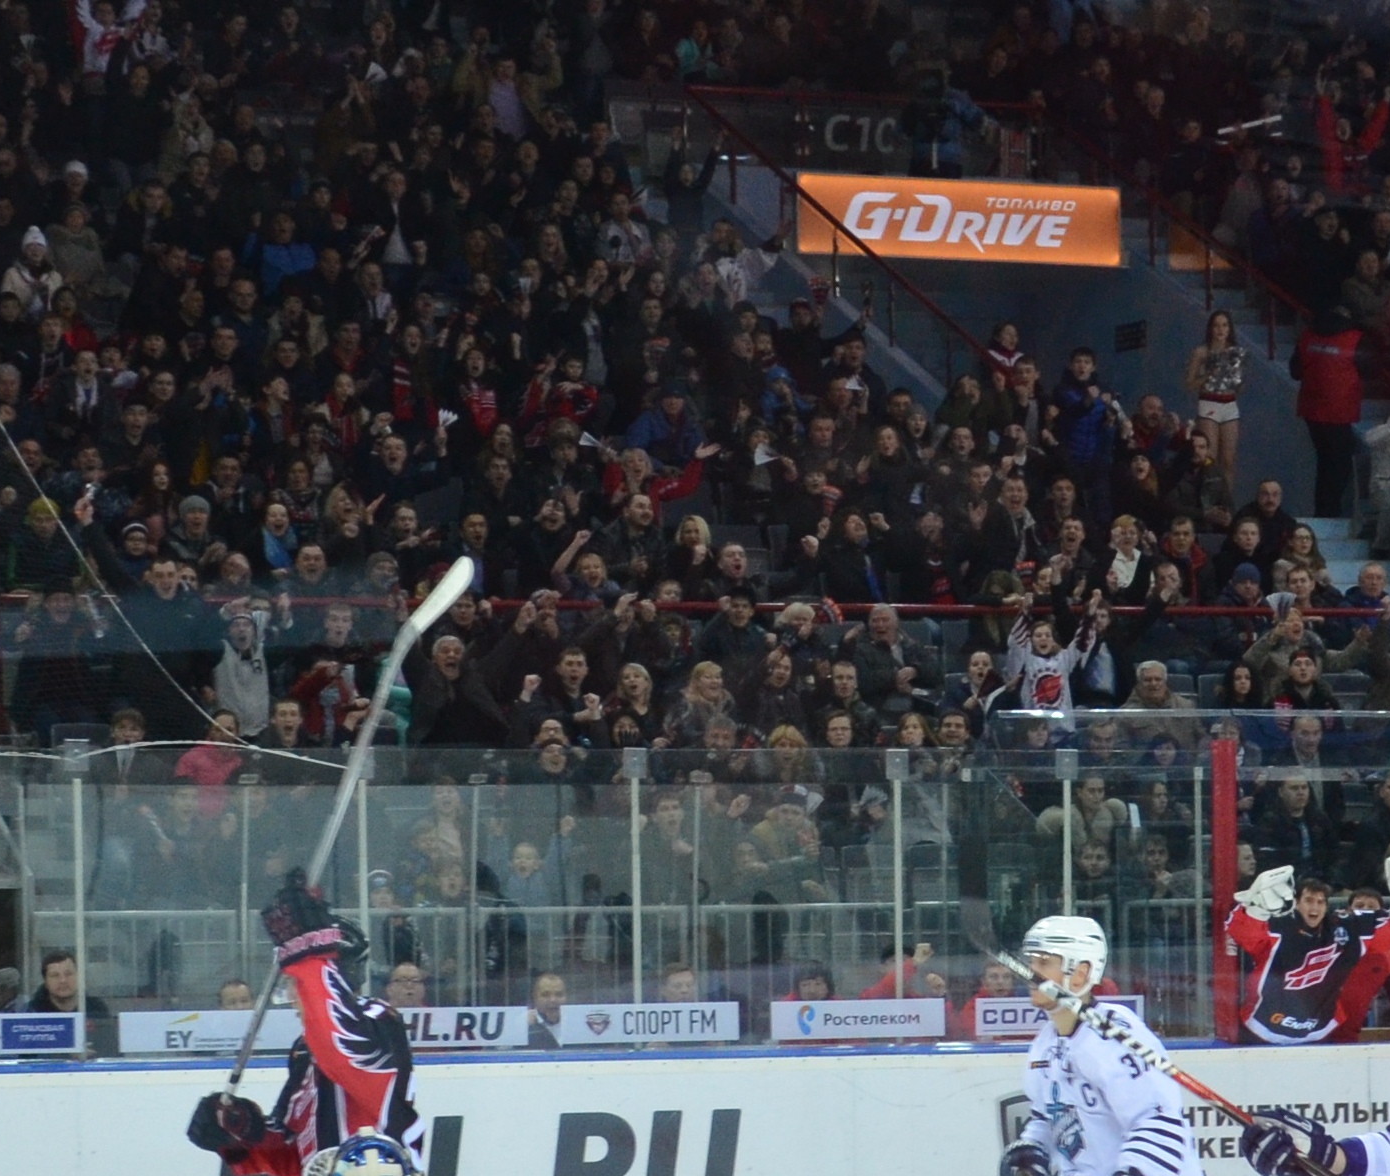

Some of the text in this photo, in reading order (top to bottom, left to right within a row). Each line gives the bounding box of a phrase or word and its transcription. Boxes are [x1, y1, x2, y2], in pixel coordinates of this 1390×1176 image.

[985, 196, 1077, 213] ТОПЛИВО
[622, 1008, 718, 1036] СПОРТ FM
[822, 1011, 921, 1028] Ростелеком
[982, 1008, 1050, 1025] СОГА
[165, 1030, 193, 1049] EY
